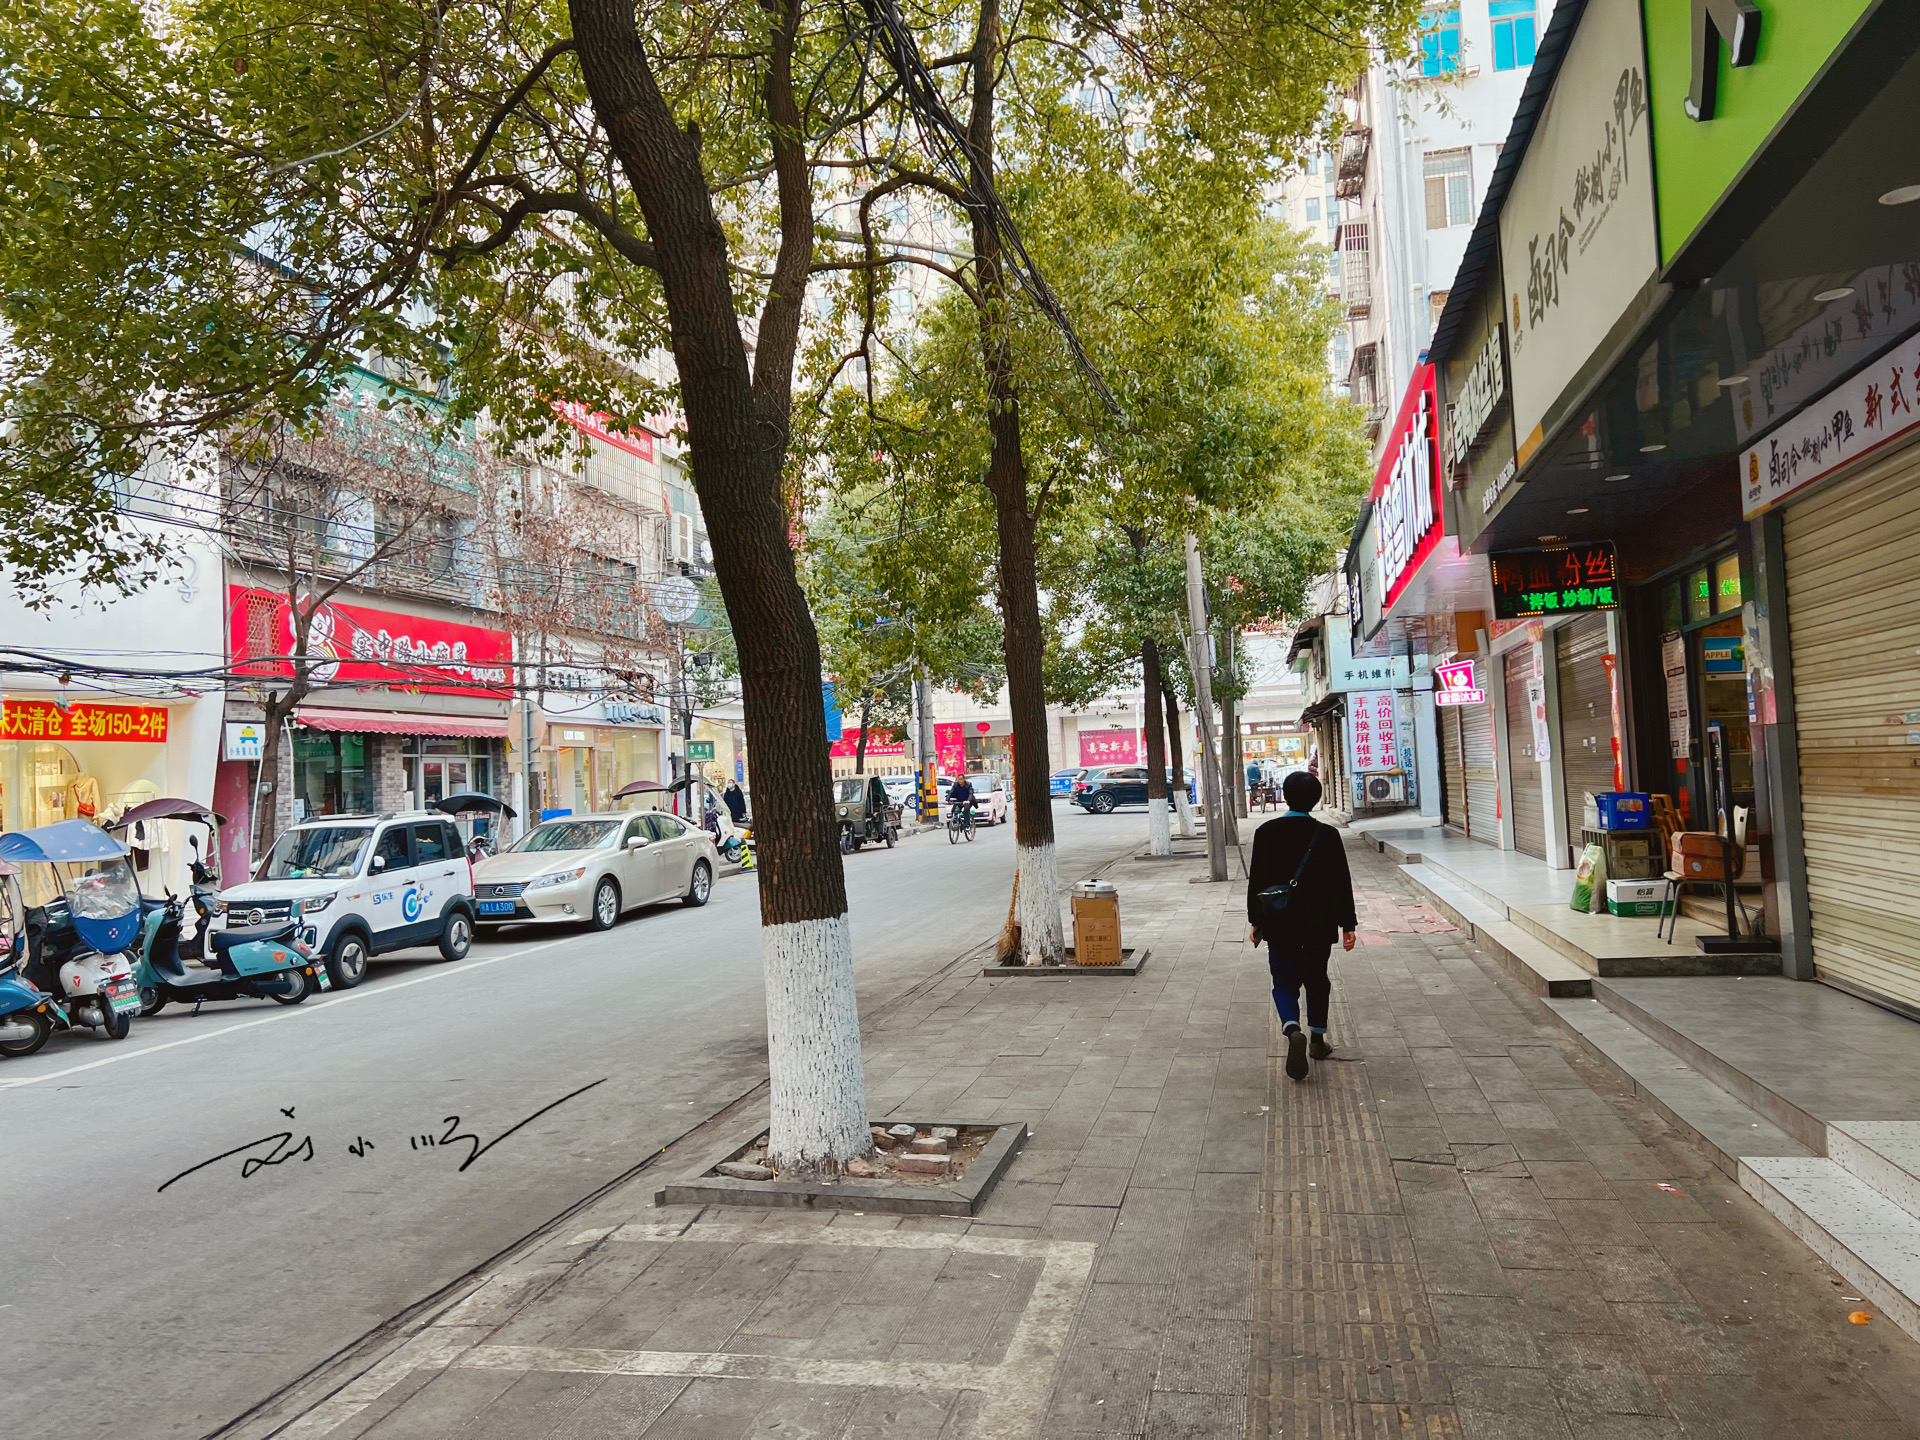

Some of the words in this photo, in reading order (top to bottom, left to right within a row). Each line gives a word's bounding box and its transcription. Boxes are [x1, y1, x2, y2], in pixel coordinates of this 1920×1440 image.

[1382, 389, 1434, 594] 蜜雪冰城
[1705, 651, 1730, 659] APPLE
[1344, 668, 1396, 681] 手机维修
[70, 708, 166, 738] 全场150-2件
[1353, 696, 1373, 767] 手机换屏维修
[1376, 695, 1397, 766] 高价回收手机
[1087, 740, 1133, 754] 喜迎新春
